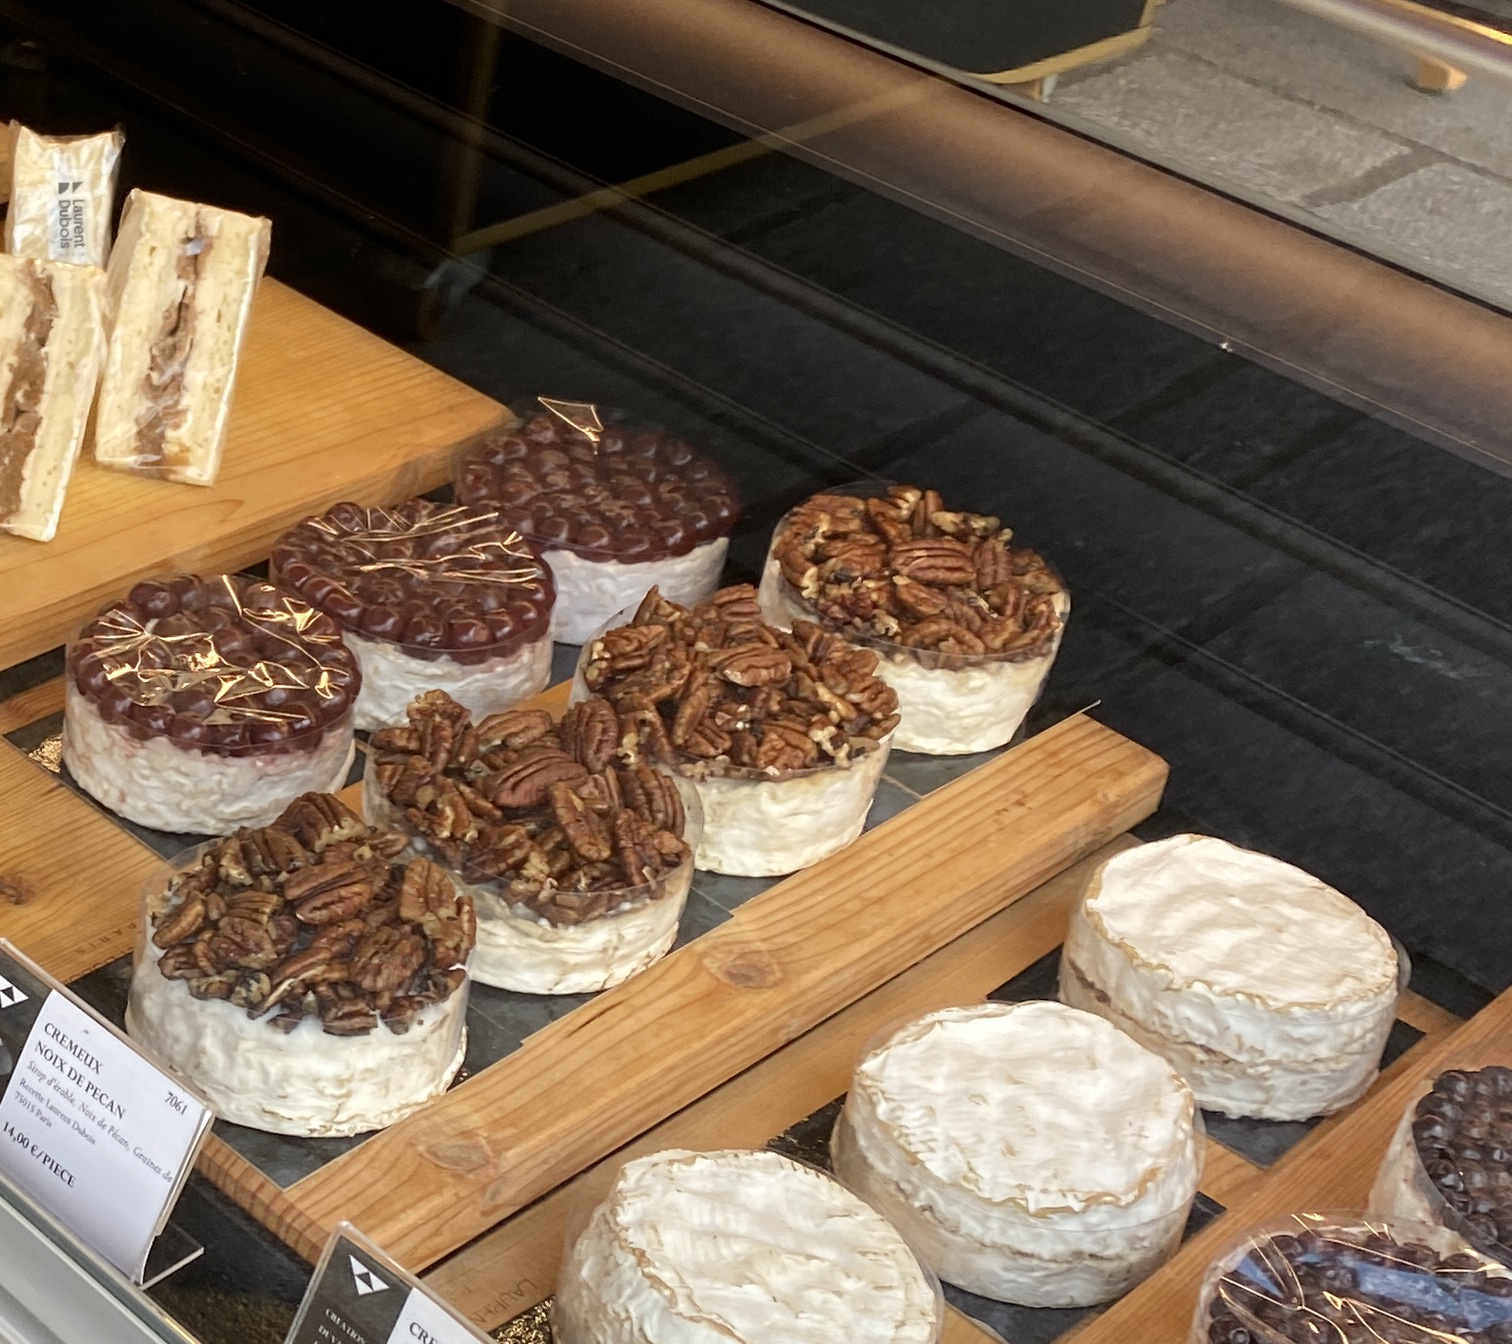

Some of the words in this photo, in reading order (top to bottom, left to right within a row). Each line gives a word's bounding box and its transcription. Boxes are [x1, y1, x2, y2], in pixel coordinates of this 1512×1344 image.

[59, 200, 71, 249] Dubois
[73, 199, 85, 248] Laurent
[43, 1021, 102, 1075] CREMEUX
[34, 1040, 67, 1073] NOIX
[66, 1066, 85, 1087] DE
[84, 1080, 125, 1119] PECAN
[14, 1090, 35, 1113] 75015
[35, 1108, 53, 1128] Paris
[45, 1098, 71, 1125] Laurent
[164, 1090, 188, 1116] 7061
[2, 1120, 30, 1150] 14,00
[96, 1116, 107, 1130] de
